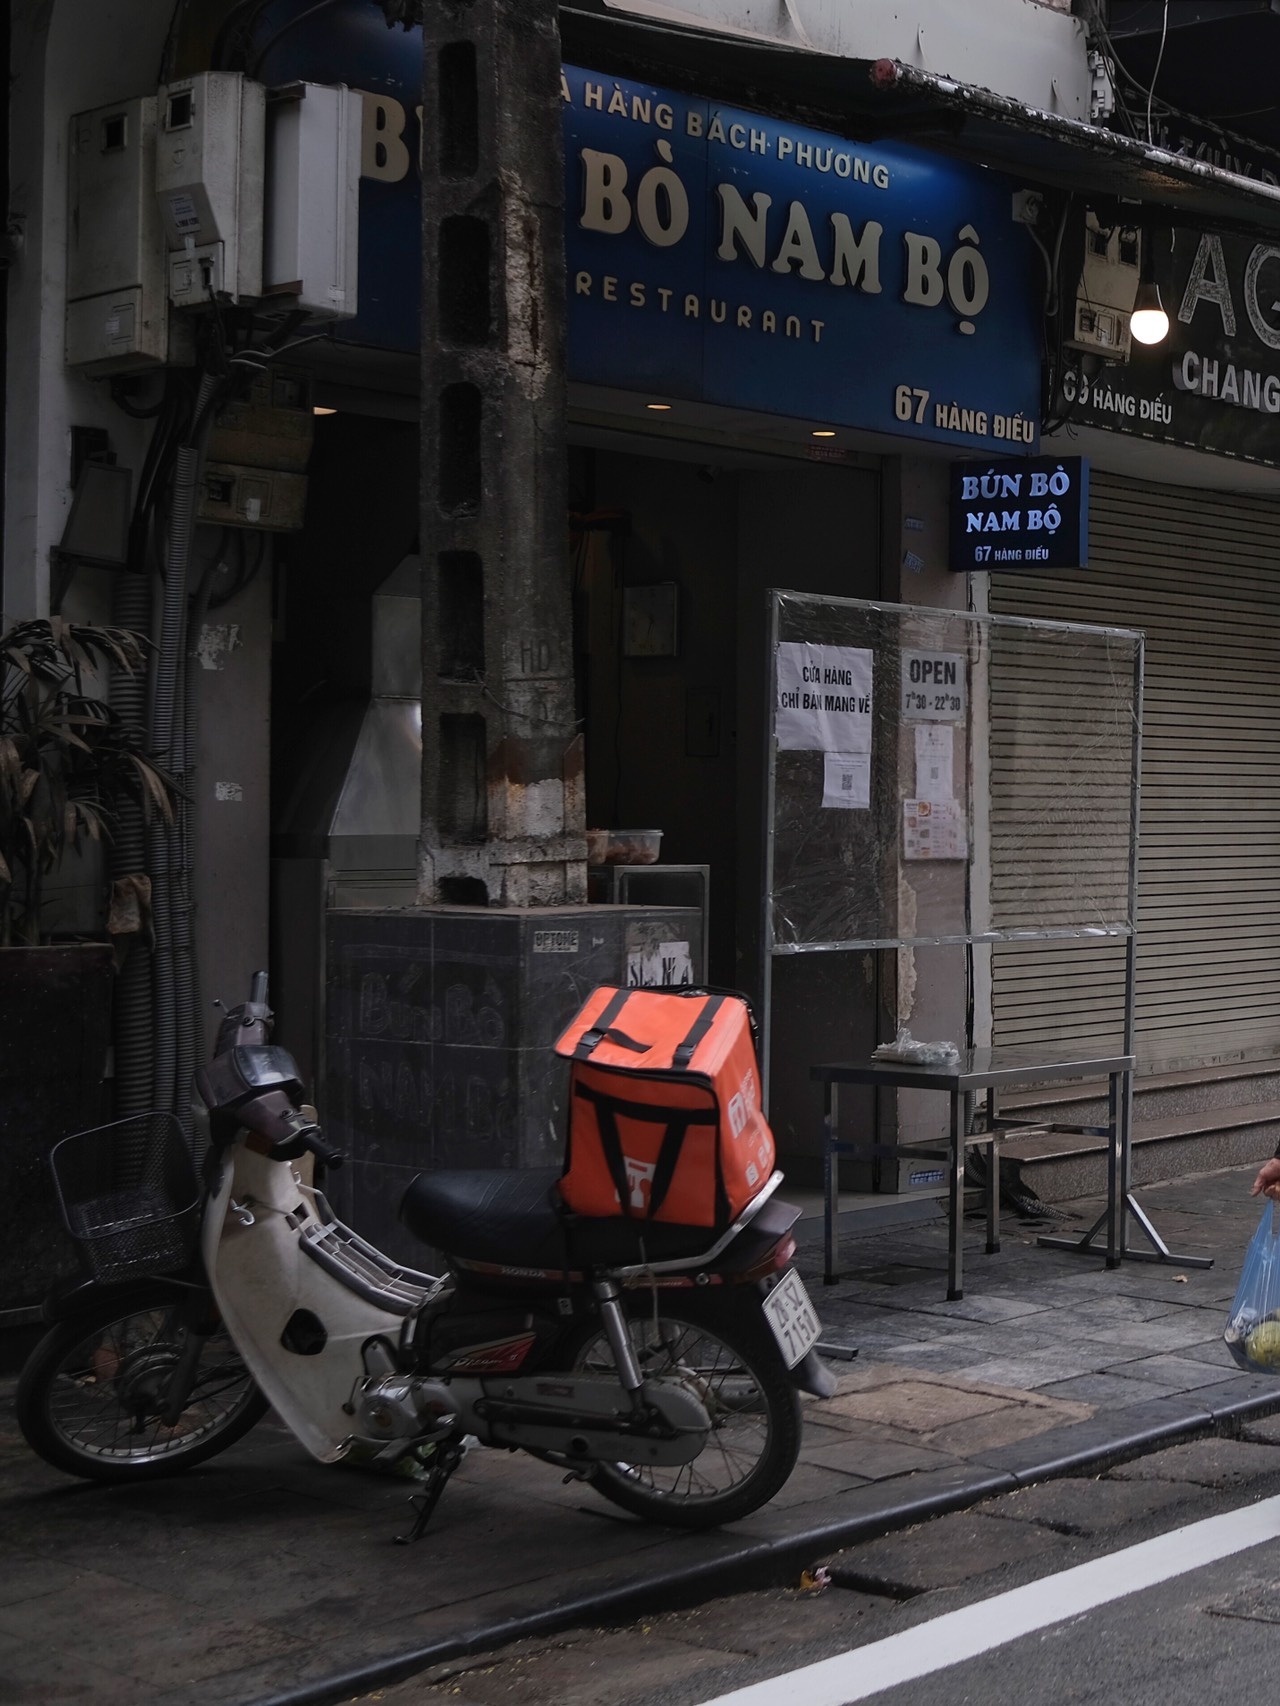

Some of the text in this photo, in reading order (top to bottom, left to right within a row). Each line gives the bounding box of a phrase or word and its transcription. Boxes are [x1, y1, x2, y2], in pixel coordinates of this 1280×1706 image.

[585, 82, 673, 130] HÀNG
[687, 111, 766, 155] BÁCH
[778, 136, 889, 189] PHƯƠNG
[580, 138, 990, 335] BÒ NAM BỘ
[575, 271, 825, 343] RESTAURANT
[1180, 350, 1280, 413] CHANG
[895, 384, 1035, 444] 67 HÀNG ĐIẾU
[1093, 384, 1136, 417] HÀNG
[1139, 392, 1172, 425] ĐIẾU
[961, 465, 1070, 500] BÚN BÒ
[966, 503, 1062, 535] NAM BỘ
[974, 545, 1050, 562] 67 HÀNG ĐIẾU
[802, 660, 852, 686] CỬA HÀNG
[910, 658, 956, 685] OPEN
[781, 686, 800, 709] CHỈ
[824, 696, 855, 713] MANG
[858, 692, 871, 714] VỀ
[501, 1265, 547, 1278] HONDA
